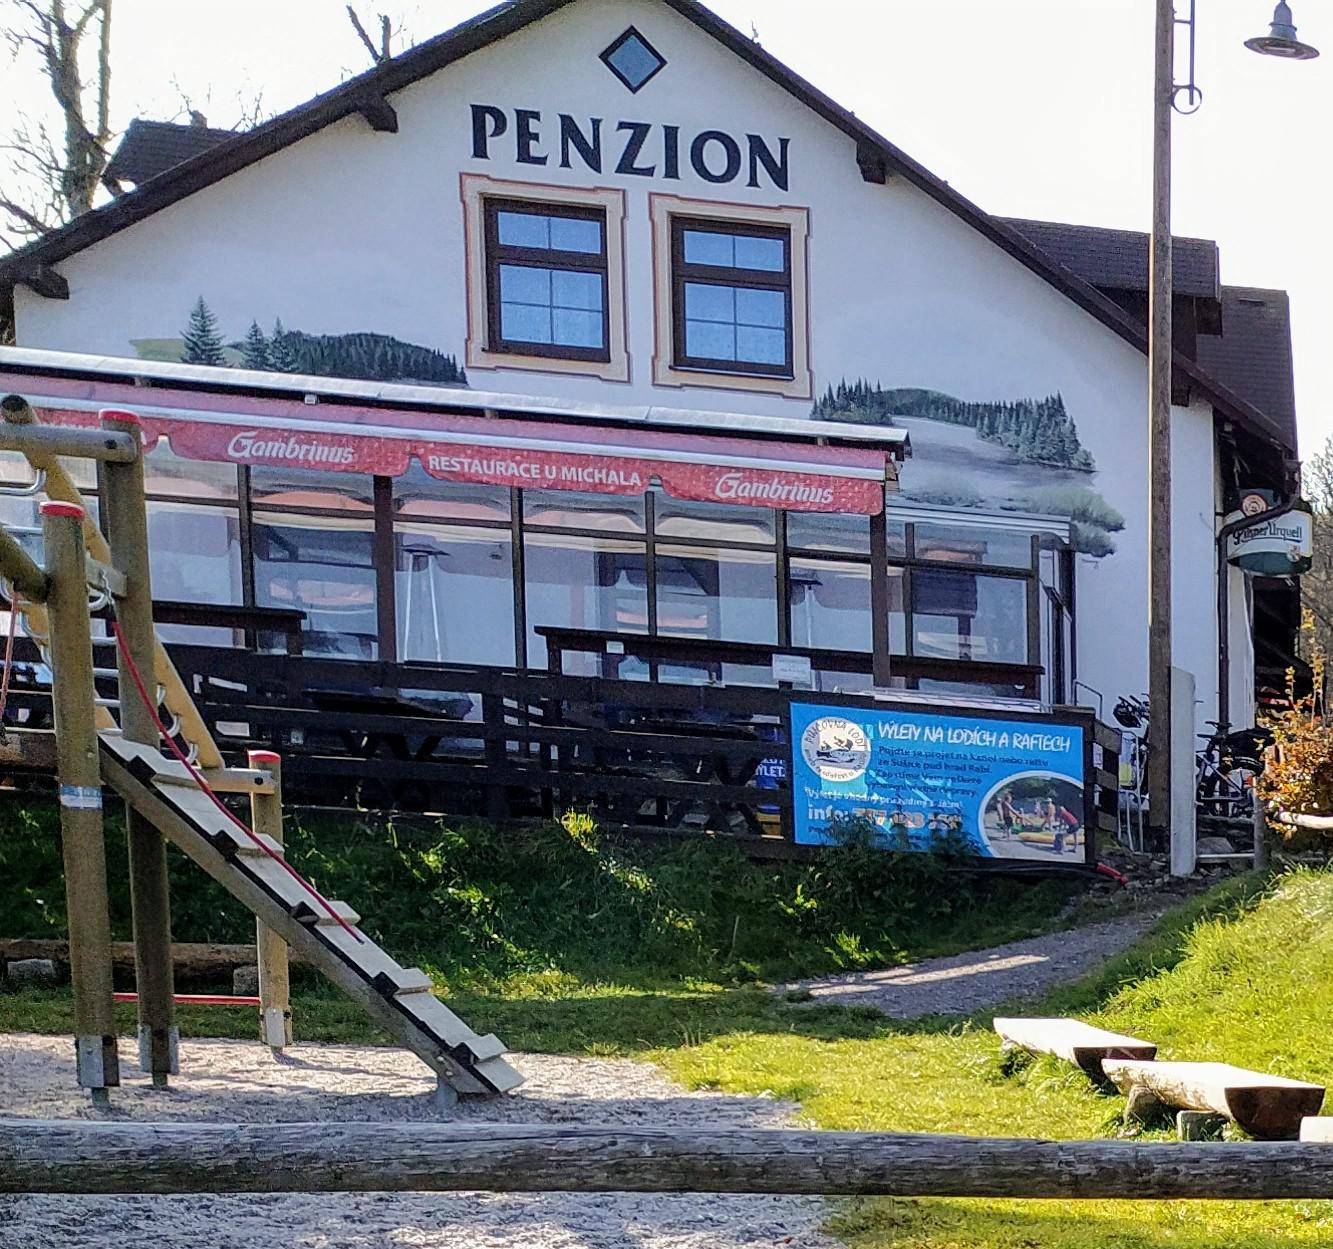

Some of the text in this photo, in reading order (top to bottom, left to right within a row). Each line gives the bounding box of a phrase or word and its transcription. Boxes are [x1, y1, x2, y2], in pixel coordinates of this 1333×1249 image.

[470, 103, 791, 192] PENZION
[227, 431, 354, 464] Gambrinus
[428, 455, 642, 486] RESTAURACE U MICHALA
[714, 472, 834, 504] Gambrinus
[878, 720, 1072, 754] VÝLETY NA LODÍCH A RAFTECH
